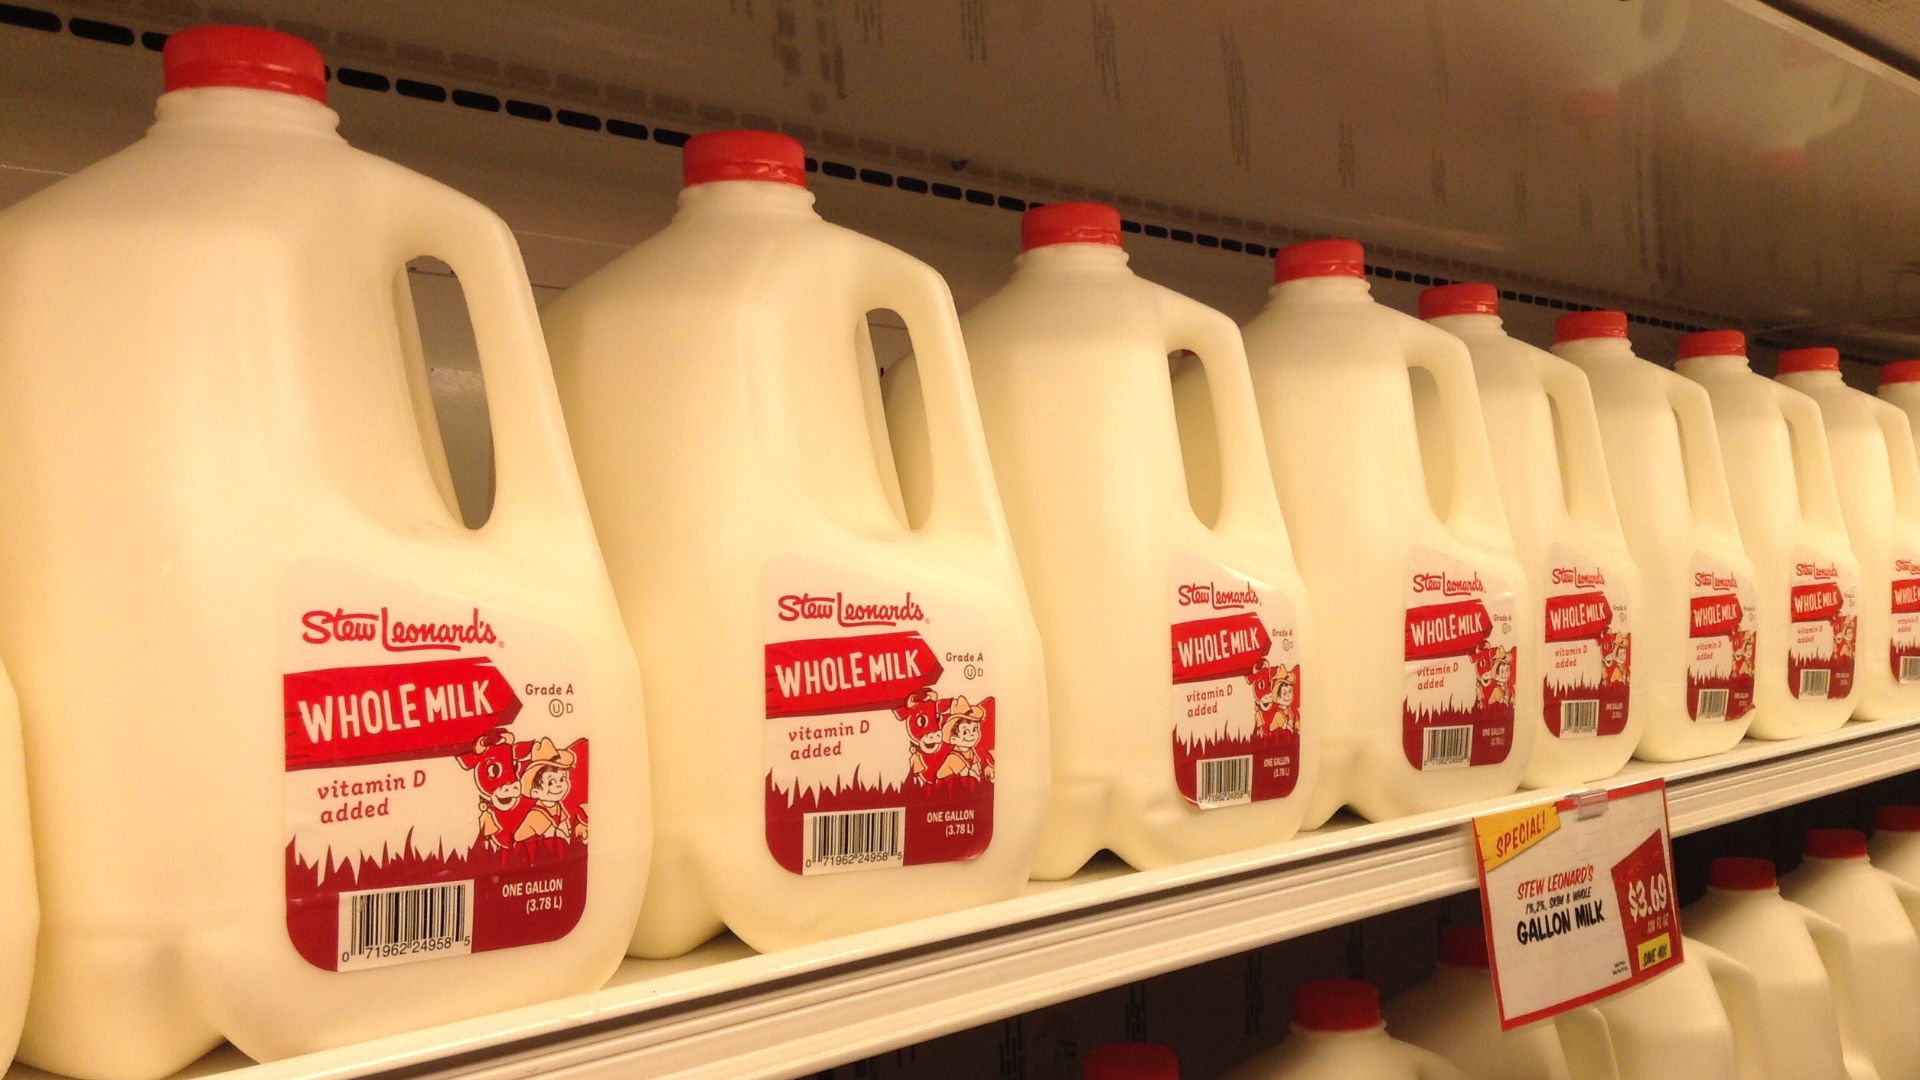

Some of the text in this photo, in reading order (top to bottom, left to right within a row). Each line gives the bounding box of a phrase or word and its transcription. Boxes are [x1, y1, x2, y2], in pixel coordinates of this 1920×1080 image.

[1413, 571, 1484, 596] Stew Leonard's
[1178, 582, 1259, 610] Stew Leonard's
[1794, 592, 1838, 614] WHOLE MILK
[778, 592, 924, 627] Stew Leonard's
[1550, 603, 1586, 631] WHOLE
[1587, 602, 1606, 622] MILK
[1694, 604, 1736, 627] WHOLE MILK
[302, 608, 497, 652] Stew Leonard's
[1410, 614, 1457, 647] WHOLE
[1458, 612, 1483, 636] MILK
[946, 652, 983, 662] Grade A
[1177, 629, 1230, 668] WHOLE
[1231, 627, 1260, 655] MILK
[1555, 646, 1582, 657] vitamin
[775, 649, 921, 698] WHOLE MILK
[978, 668, 984, 677] D
[1417, 664, 1458, 677] vitamin D
[1556, 658, 1577, 668] added
[525, 684, 574, 696] Grade A
[1186, 685, 1233, 703] vitamin D
[1418, 677, 1444, 691] added
[298, 680, 493, 744] WHOLE MILK
[566, 704, 573, 714] D
[1188, 702, 1217, 718] added
[789, 720, 870, 742] vitamin D
[790, 742, 842, 760] added
[317, 770, 426, 800] vitamin D
[320, 798, 389, 824] added
[927, 810, 974, 823] ONE GALLON
[945, 824, 974, 836] (3.78 L)
[1496, 810, 1545, 858] SPECIAL!
[502, 879, 563, 898] ONE GALLON
[1517, 864, 1594, 900] STEW LEONARD'S
[526, 896, 562, 914] (3.78 L)
[1628, 873, 1667, 923] $3.69
[1517, 899, 1604, 945] GALLON MILK
[342, 951, 349, 963] 0
[464, 935, 471, 946] 5
